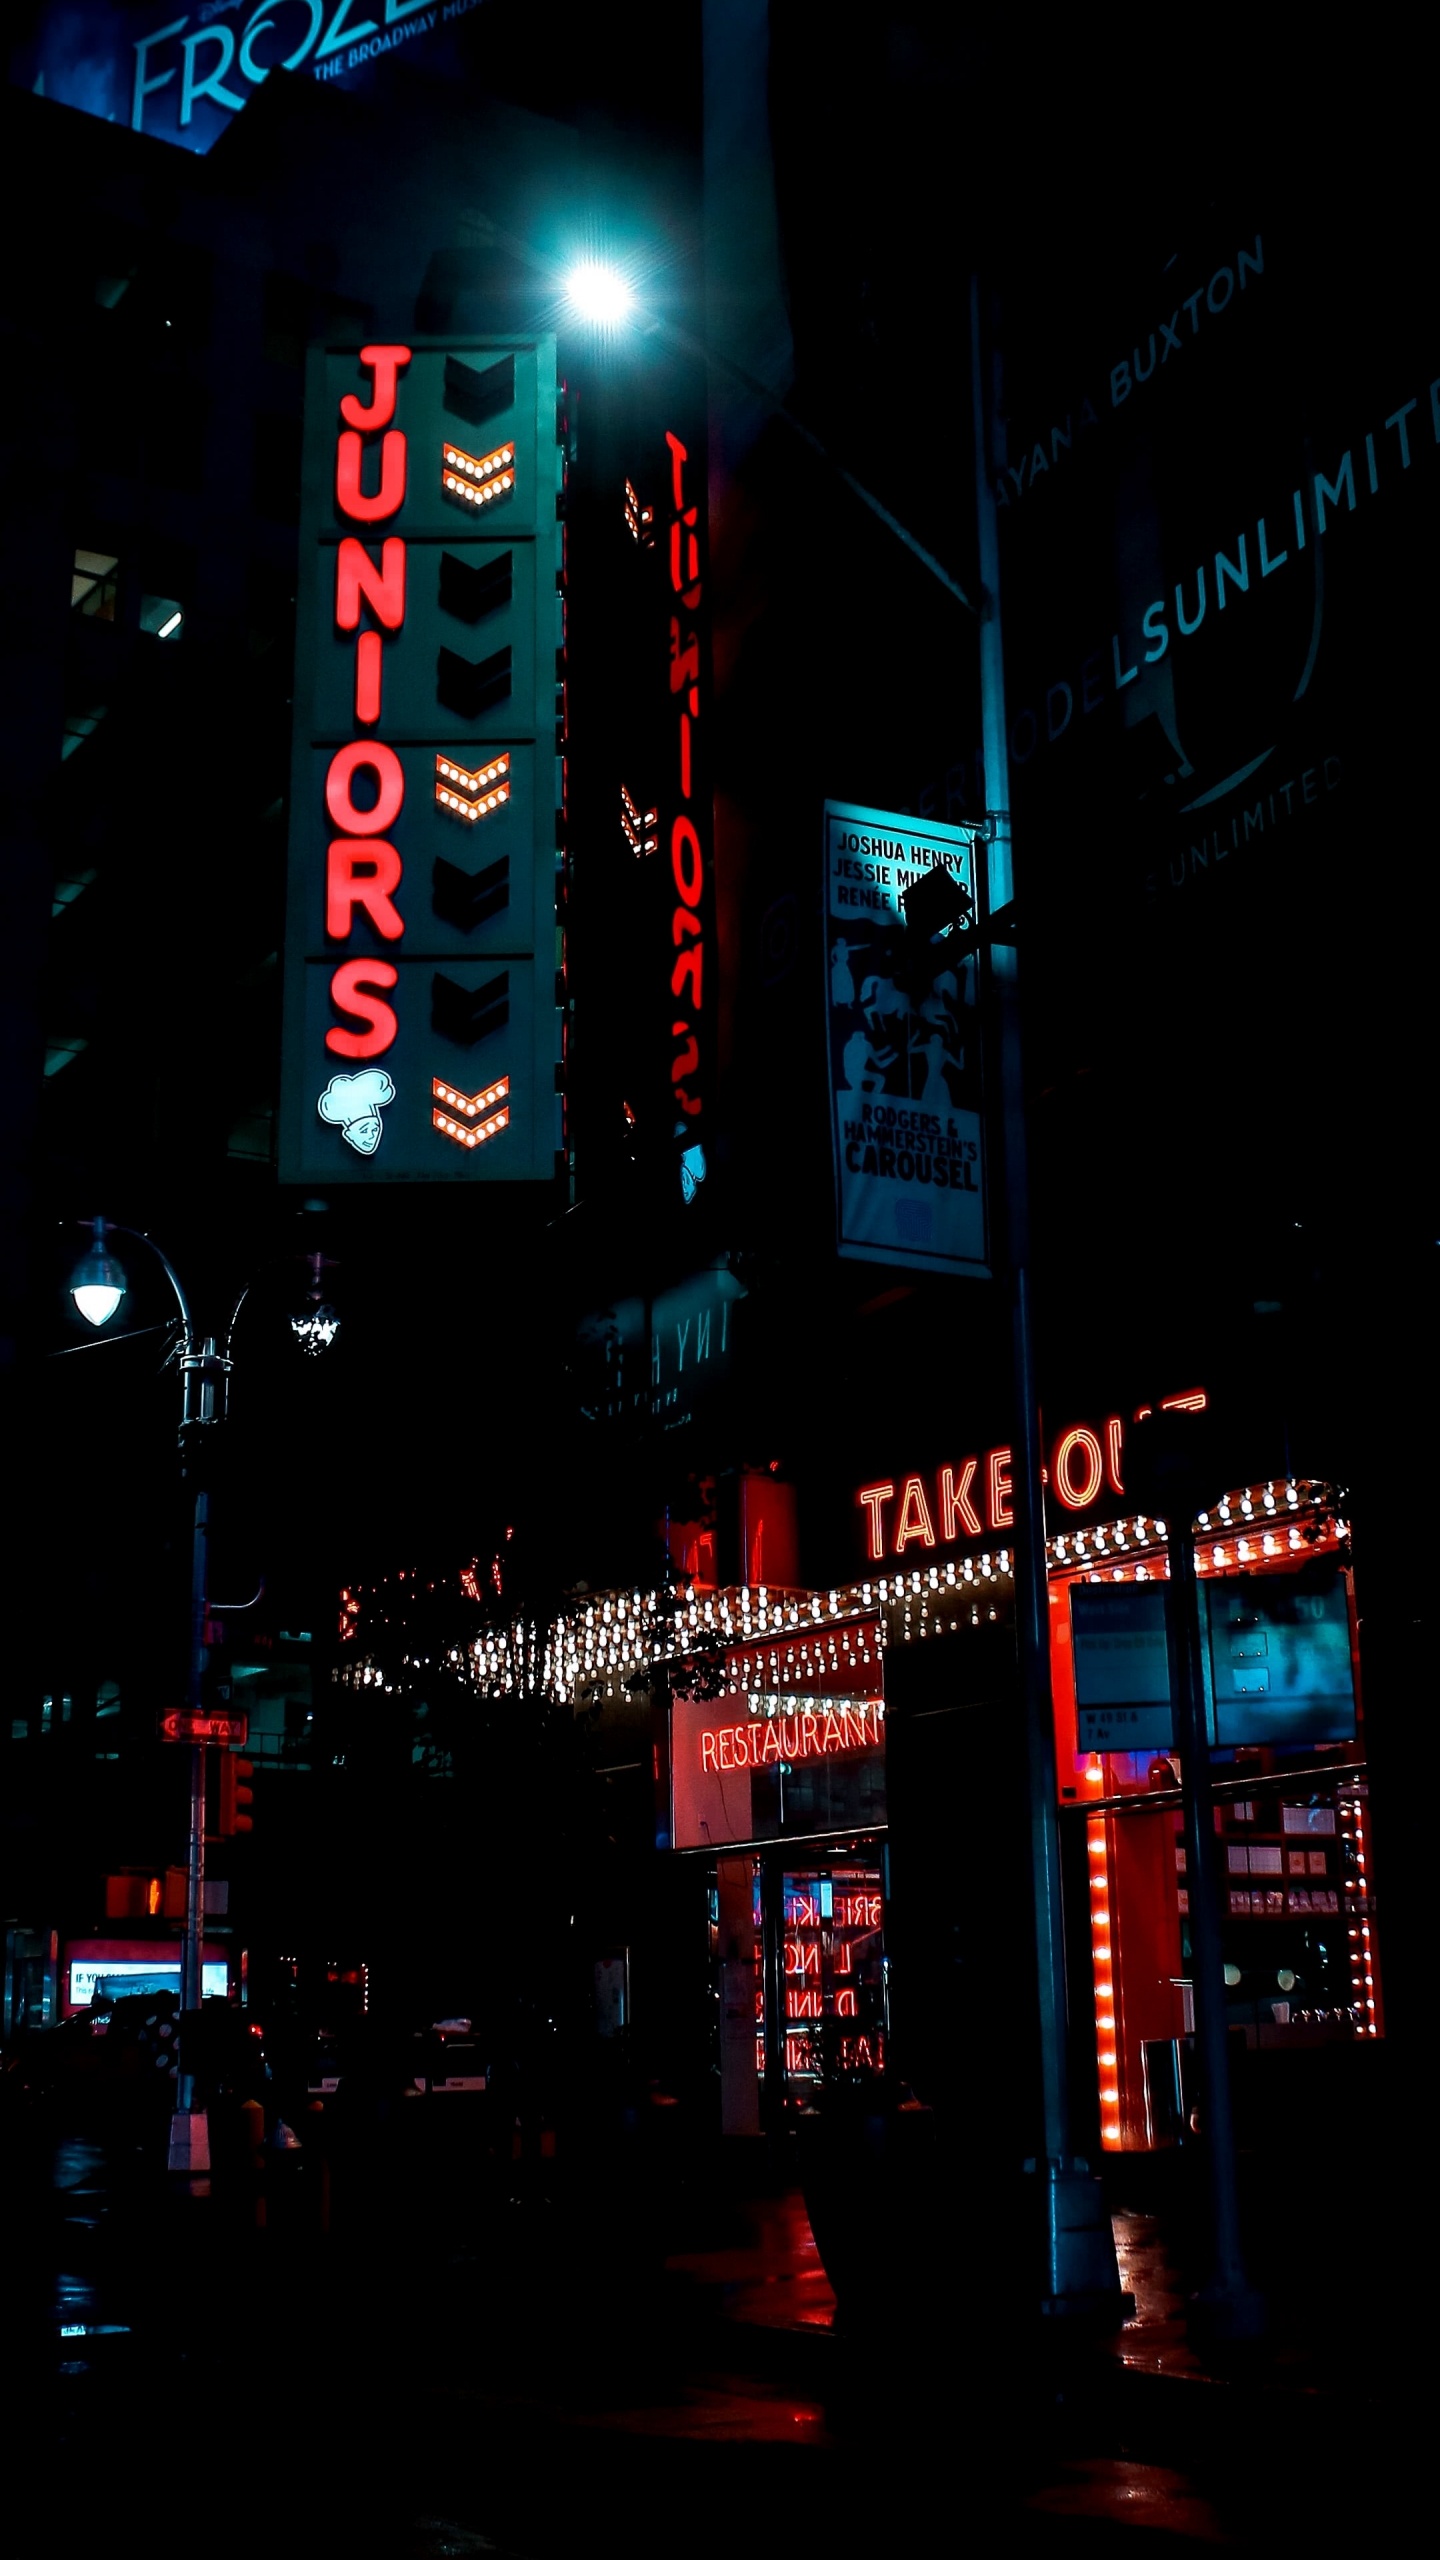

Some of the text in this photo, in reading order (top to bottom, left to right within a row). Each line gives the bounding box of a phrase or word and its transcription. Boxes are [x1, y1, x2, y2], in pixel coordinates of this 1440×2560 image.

[313, 54, 344, 82] THE
[347, 8, 438, 69] BROADWAY
[1109, 231, 1265, 409] BUXTON
[324, 344, 412, 1061] JUNIORS
[1167, 752, 1344, 891] UNLIMITED
[833, 858, 891, 885] JESSIE
[837, 832, 964, 874] JOSHUA HENRY
[843, 1120, 977, 1161] HAMMERSTEIN'S
[862, 1103, 958, 1138] RODGERS &
[845, 1141, 979, 1193] CAROUSEL
[209, 1719, 241, 1736] WAY
[701, 1699, 886, 1773] RESTAURANT
[75, 1973, 85, 1983] IF
